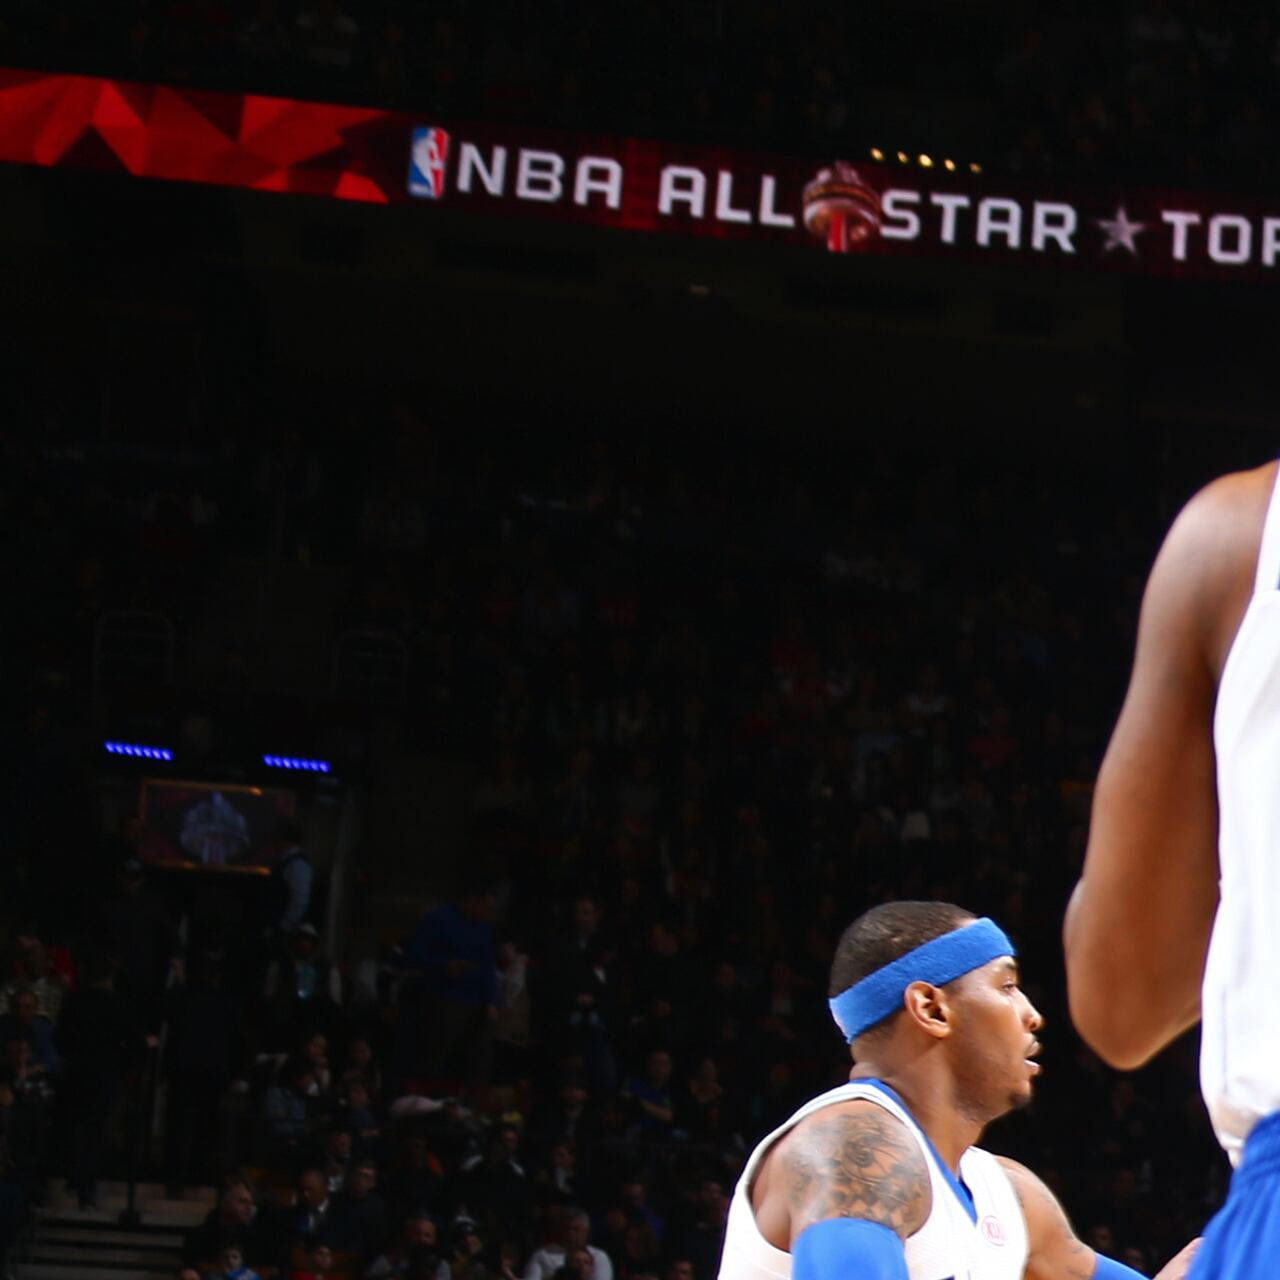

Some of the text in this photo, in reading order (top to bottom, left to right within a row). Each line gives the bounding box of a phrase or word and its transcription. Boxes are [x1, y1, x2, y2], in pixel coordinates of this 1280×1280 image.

[457, 144, 622, 209] NBA
[658, 166, 796, 227] ALL
[879, 189, 1077, 253] STAR
